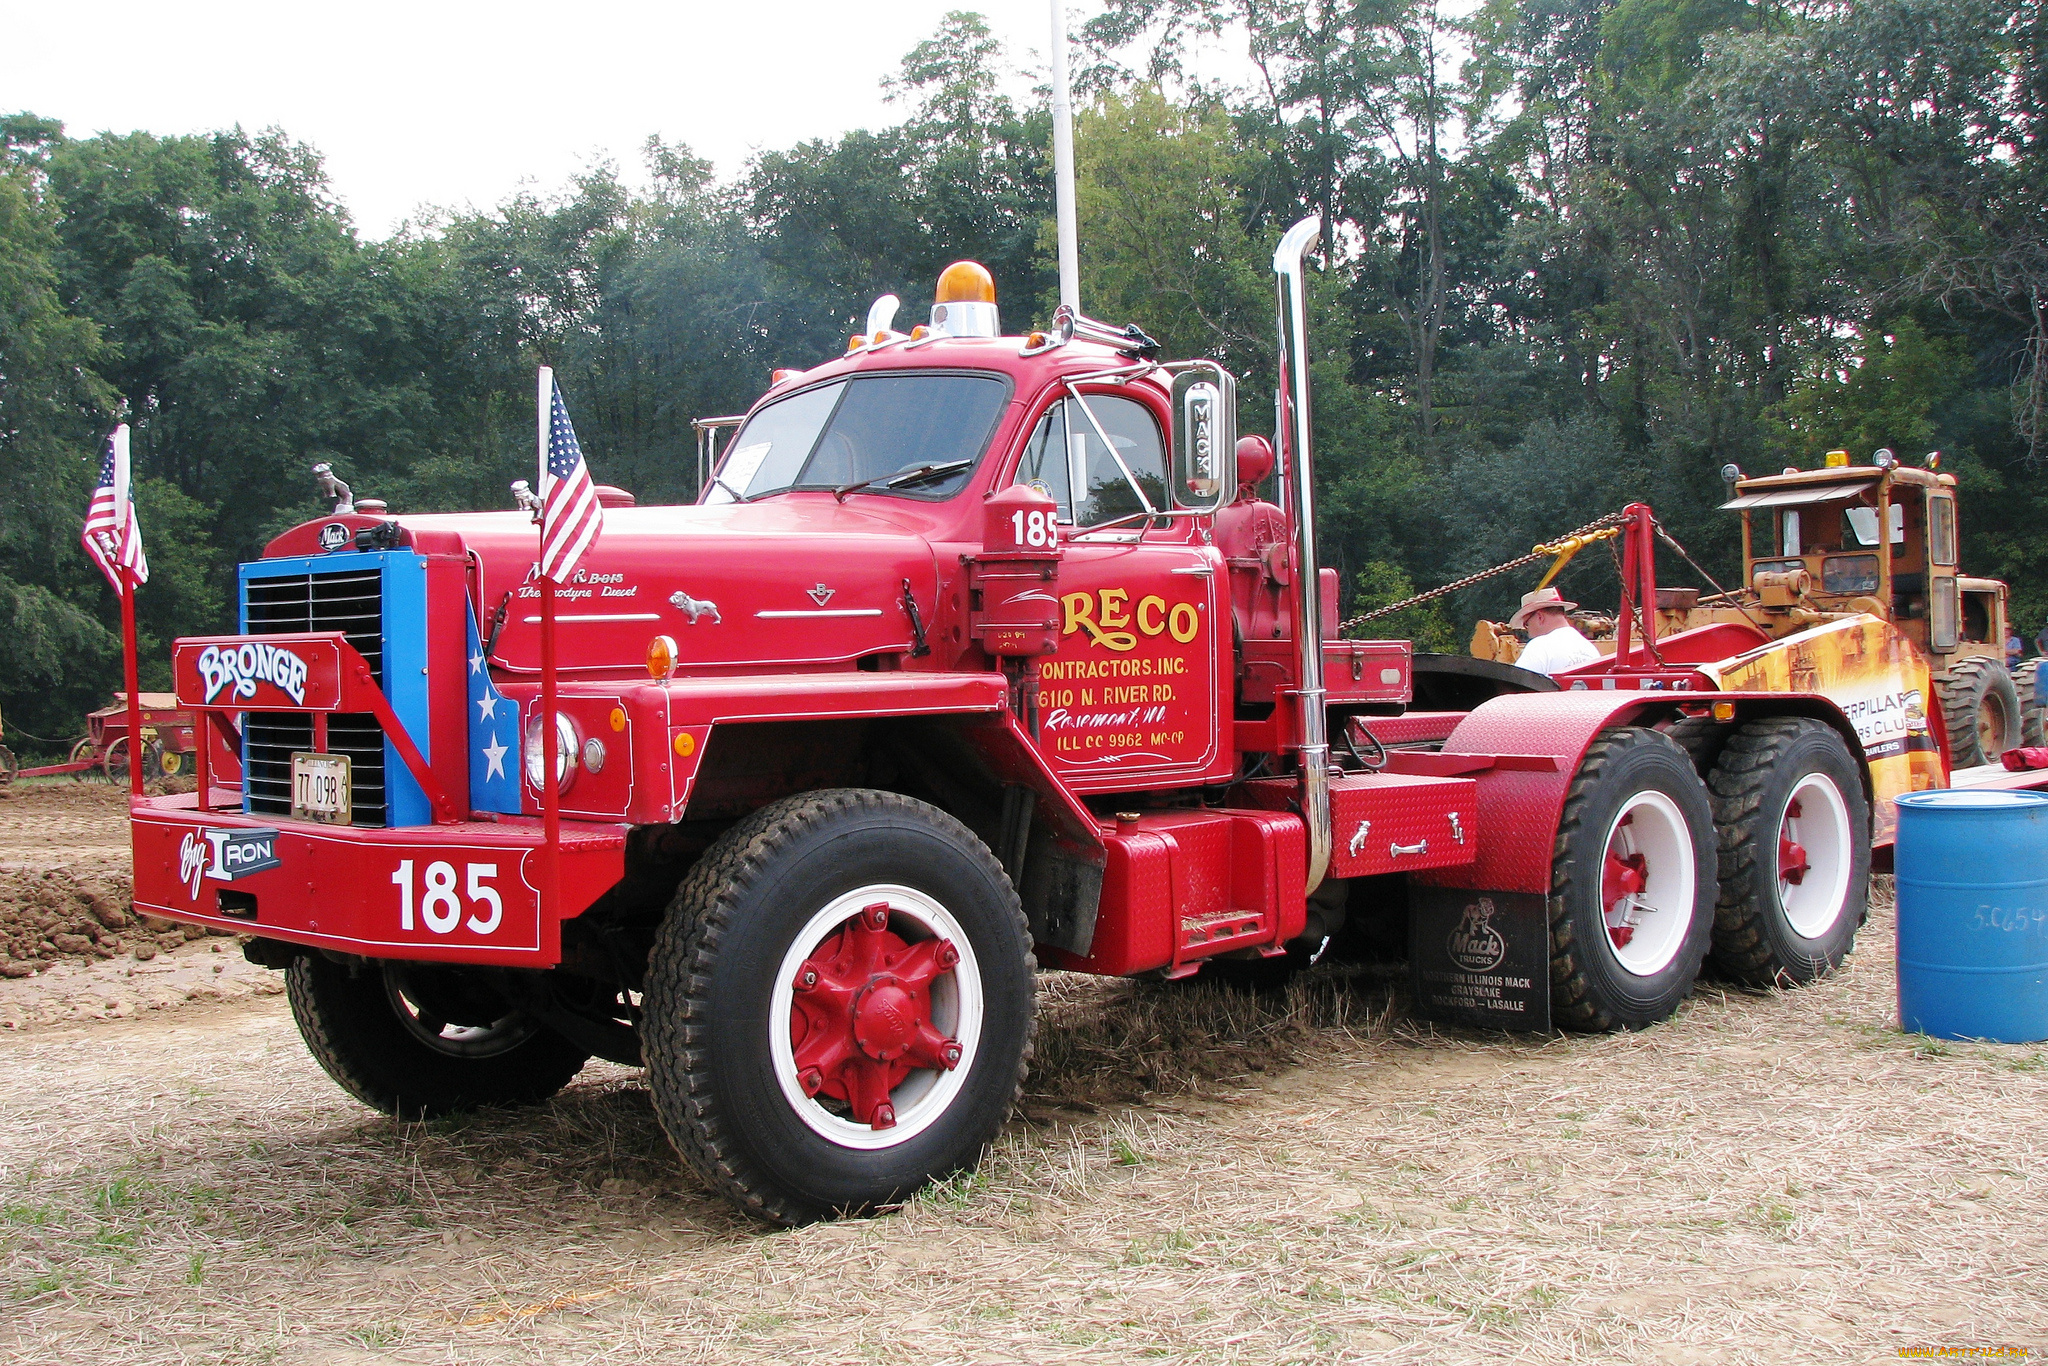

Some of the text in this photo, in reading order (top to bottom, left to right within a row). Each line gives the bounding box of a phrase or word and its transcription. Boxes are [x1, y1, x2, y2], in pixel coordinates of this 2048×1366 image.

[1194, 404, 1210, 474] MACK
[1011, 510, 1058, 549] 185
[518, 585, 592, 602] Theodyne
[197, 643, 308, 706] BRONGE
[1039, 657, 1190, 680] ONTRACTORS.INC.
[1038, 684, 1177, 708] 6110 N. RIVER RD.
[1843, 693, 1904, 719] ERPILLAR
[1874, 717, 1906, 736] CLU
[1056, 736, 1082, 751] ILL
[1109, 732, 1143, 748] 9962
[1865, 741, 1899, 756] RAWLERS
[298, 773, 311, 803] 77
[316, 775, 337, 805] 098
[180, 826, 272, 901] Big IRON
[391, 859, 503, 935] 185
[1452, 932, 1500, 956] Mack
[1460, 955, 1493, 965] TRUCKS
[1451, 984, 1501, 998] GRAYSLAKE
[1467, 973, 1503, 986] ILLINOIS
[1505, 976, 1531, 989] MACK
[1487, 998, 1525, 1012] LASALLE
